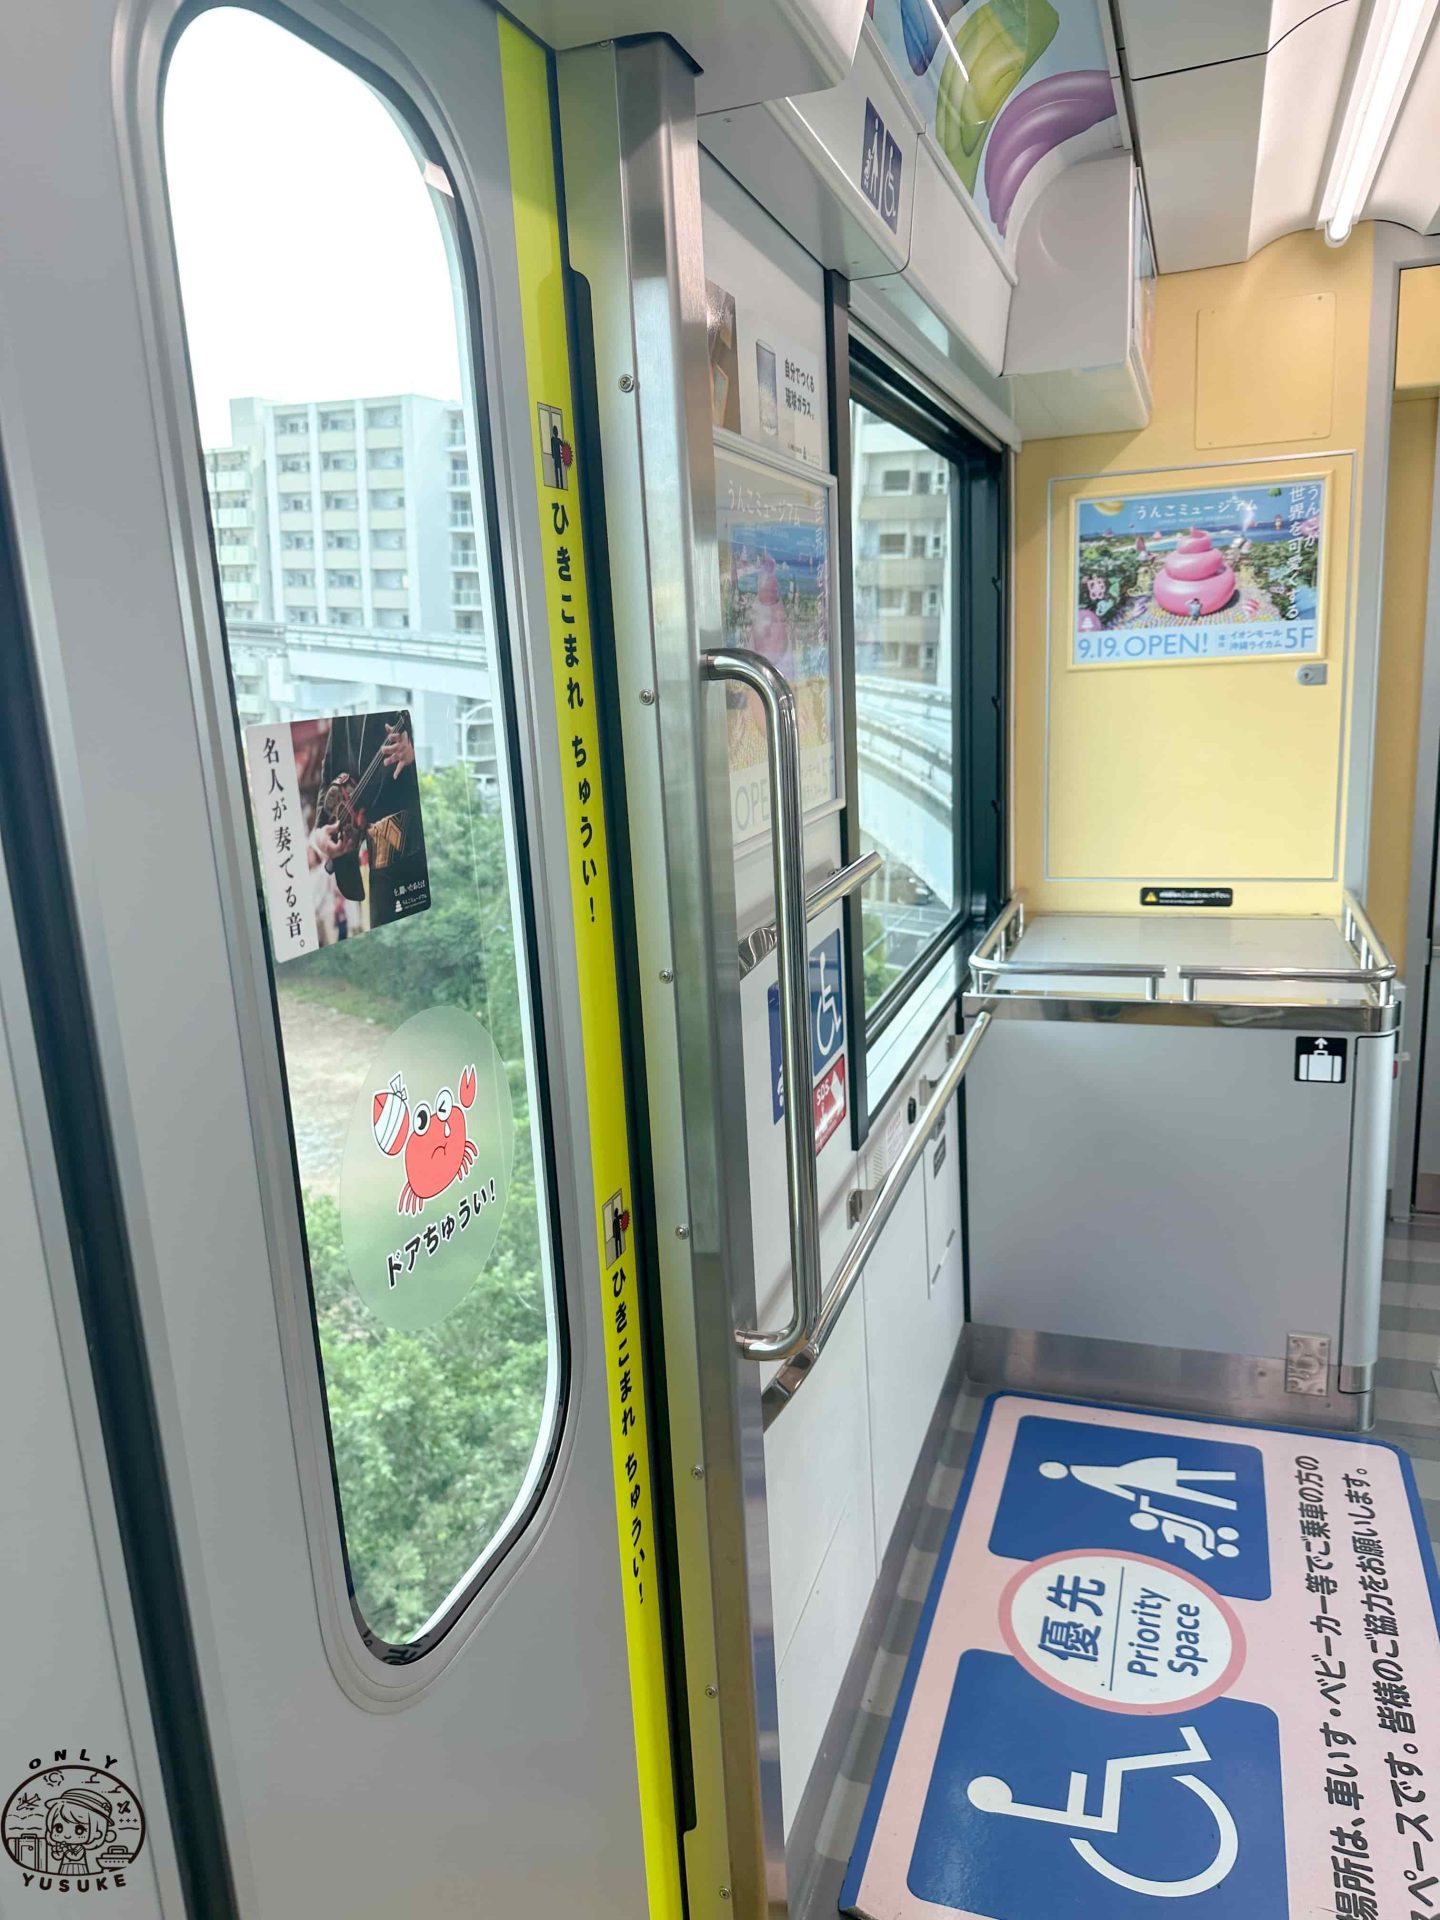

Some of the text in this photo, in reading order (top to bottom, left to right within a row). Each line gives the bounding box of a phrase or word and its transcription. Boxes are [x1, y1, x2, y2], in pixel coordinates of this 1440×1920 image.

[784, 358, 815, 393] 自分でつくる
[1137, 496, 1258, 520] うんこミュージアム
[1285, 486, 1305, 620] 世界を可愛くする
[1124, 632, 1208, 656] OPEN!
[1284, 627, 1315, 648] 5F
[551, 502, 597, 923] ひきこまれ ちゅうい！
[386, 1179, 496, 1288] ドアちゅうい！
[611, 1266, 647, 1605] ひきこまれ ちゅうい！
[1038, 1574, 1106, 1662] 優先
[1127, 1587, 1171, 1677] Priority
[1167, 1603, 1208, 1677] Space
